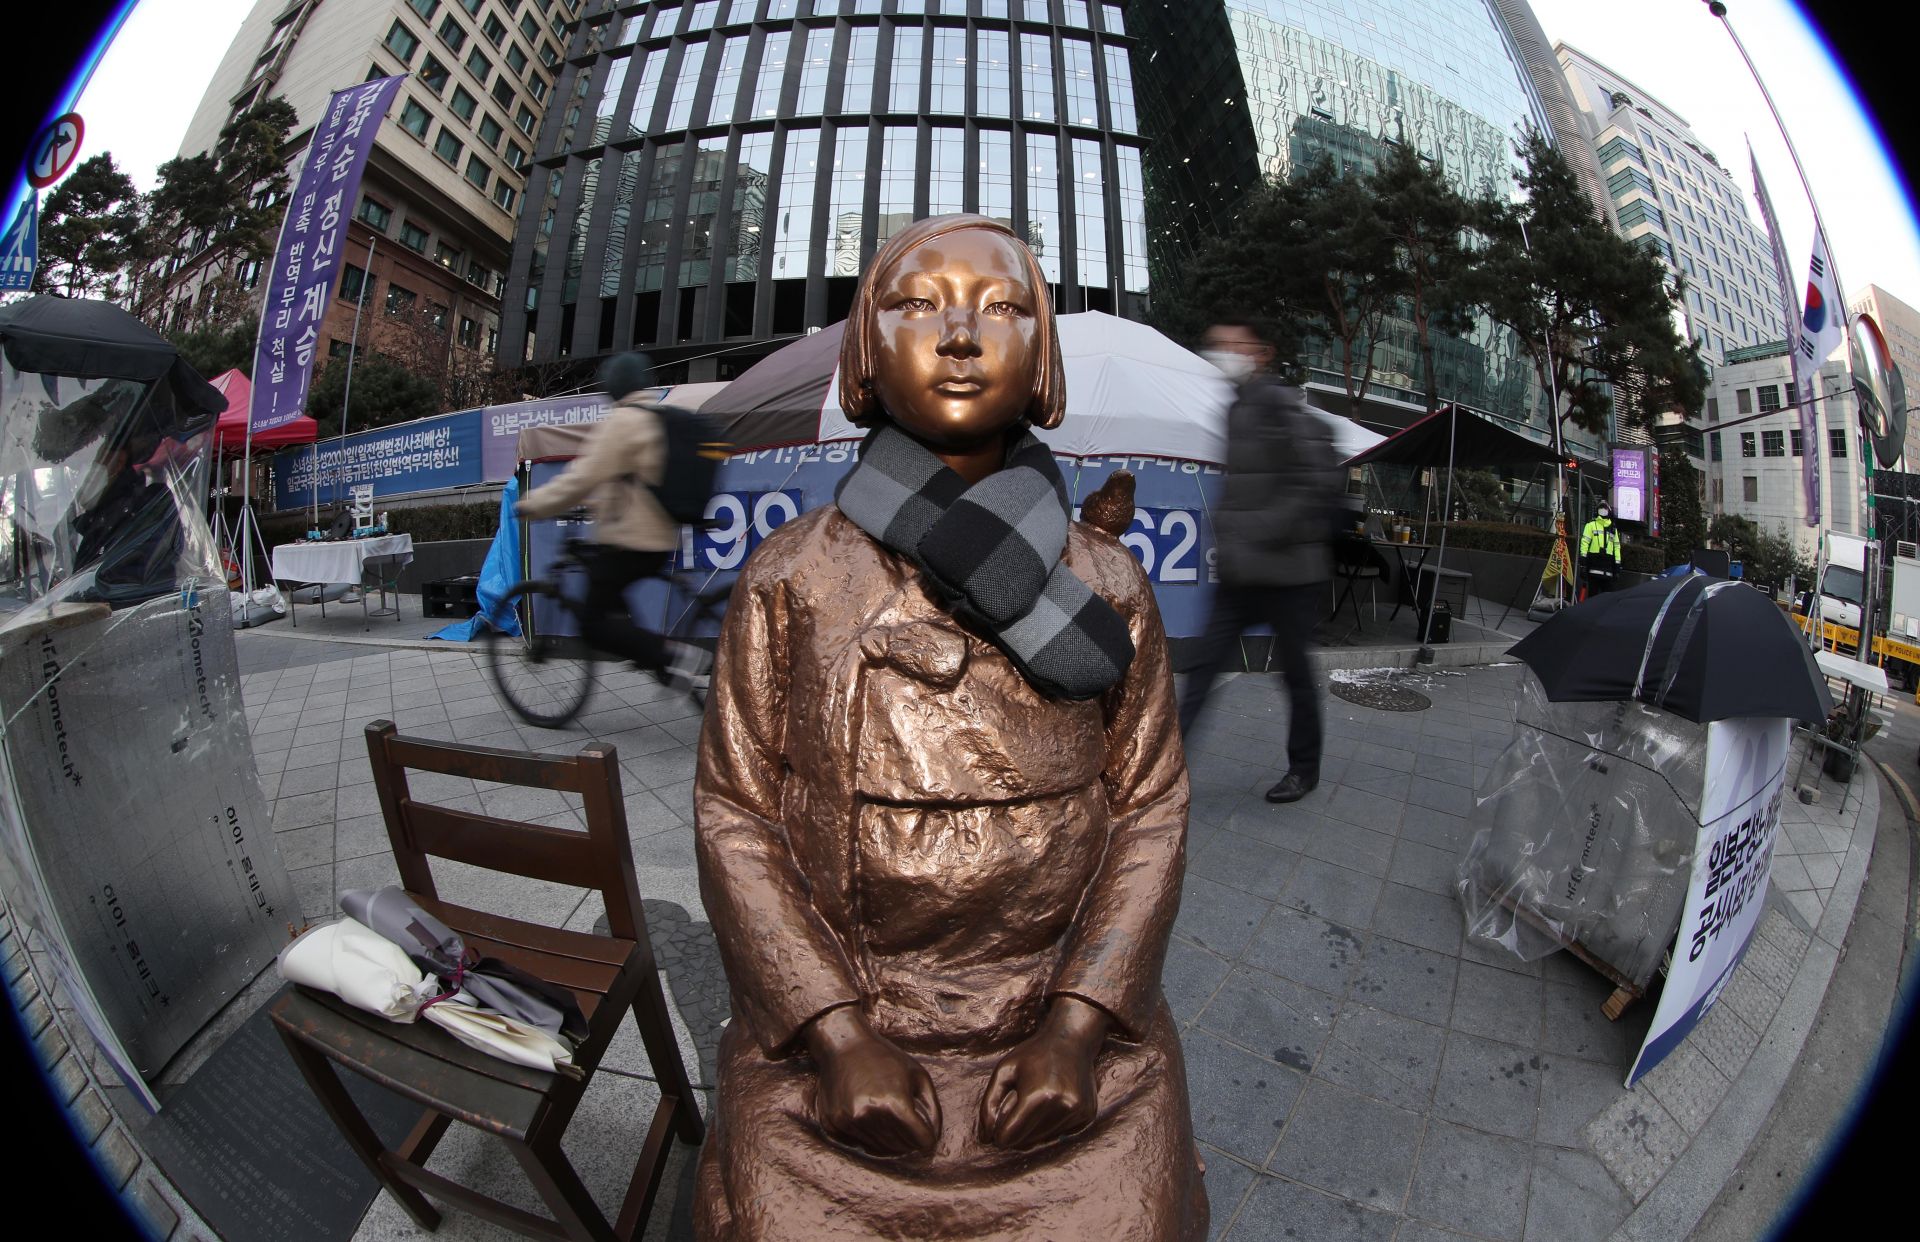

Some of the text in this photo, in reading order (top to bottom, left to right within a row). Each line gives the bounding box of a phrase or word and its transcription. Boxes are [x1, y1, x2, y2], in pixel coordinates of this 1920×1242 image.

[329, 92, 353, 129] 친일
[332, 80, 391, 182] 김학순
[296, 191, 316, 233] 민족
[312, 188, 344, 272] 정신
[275, 241, 305, 330] 반역무리
